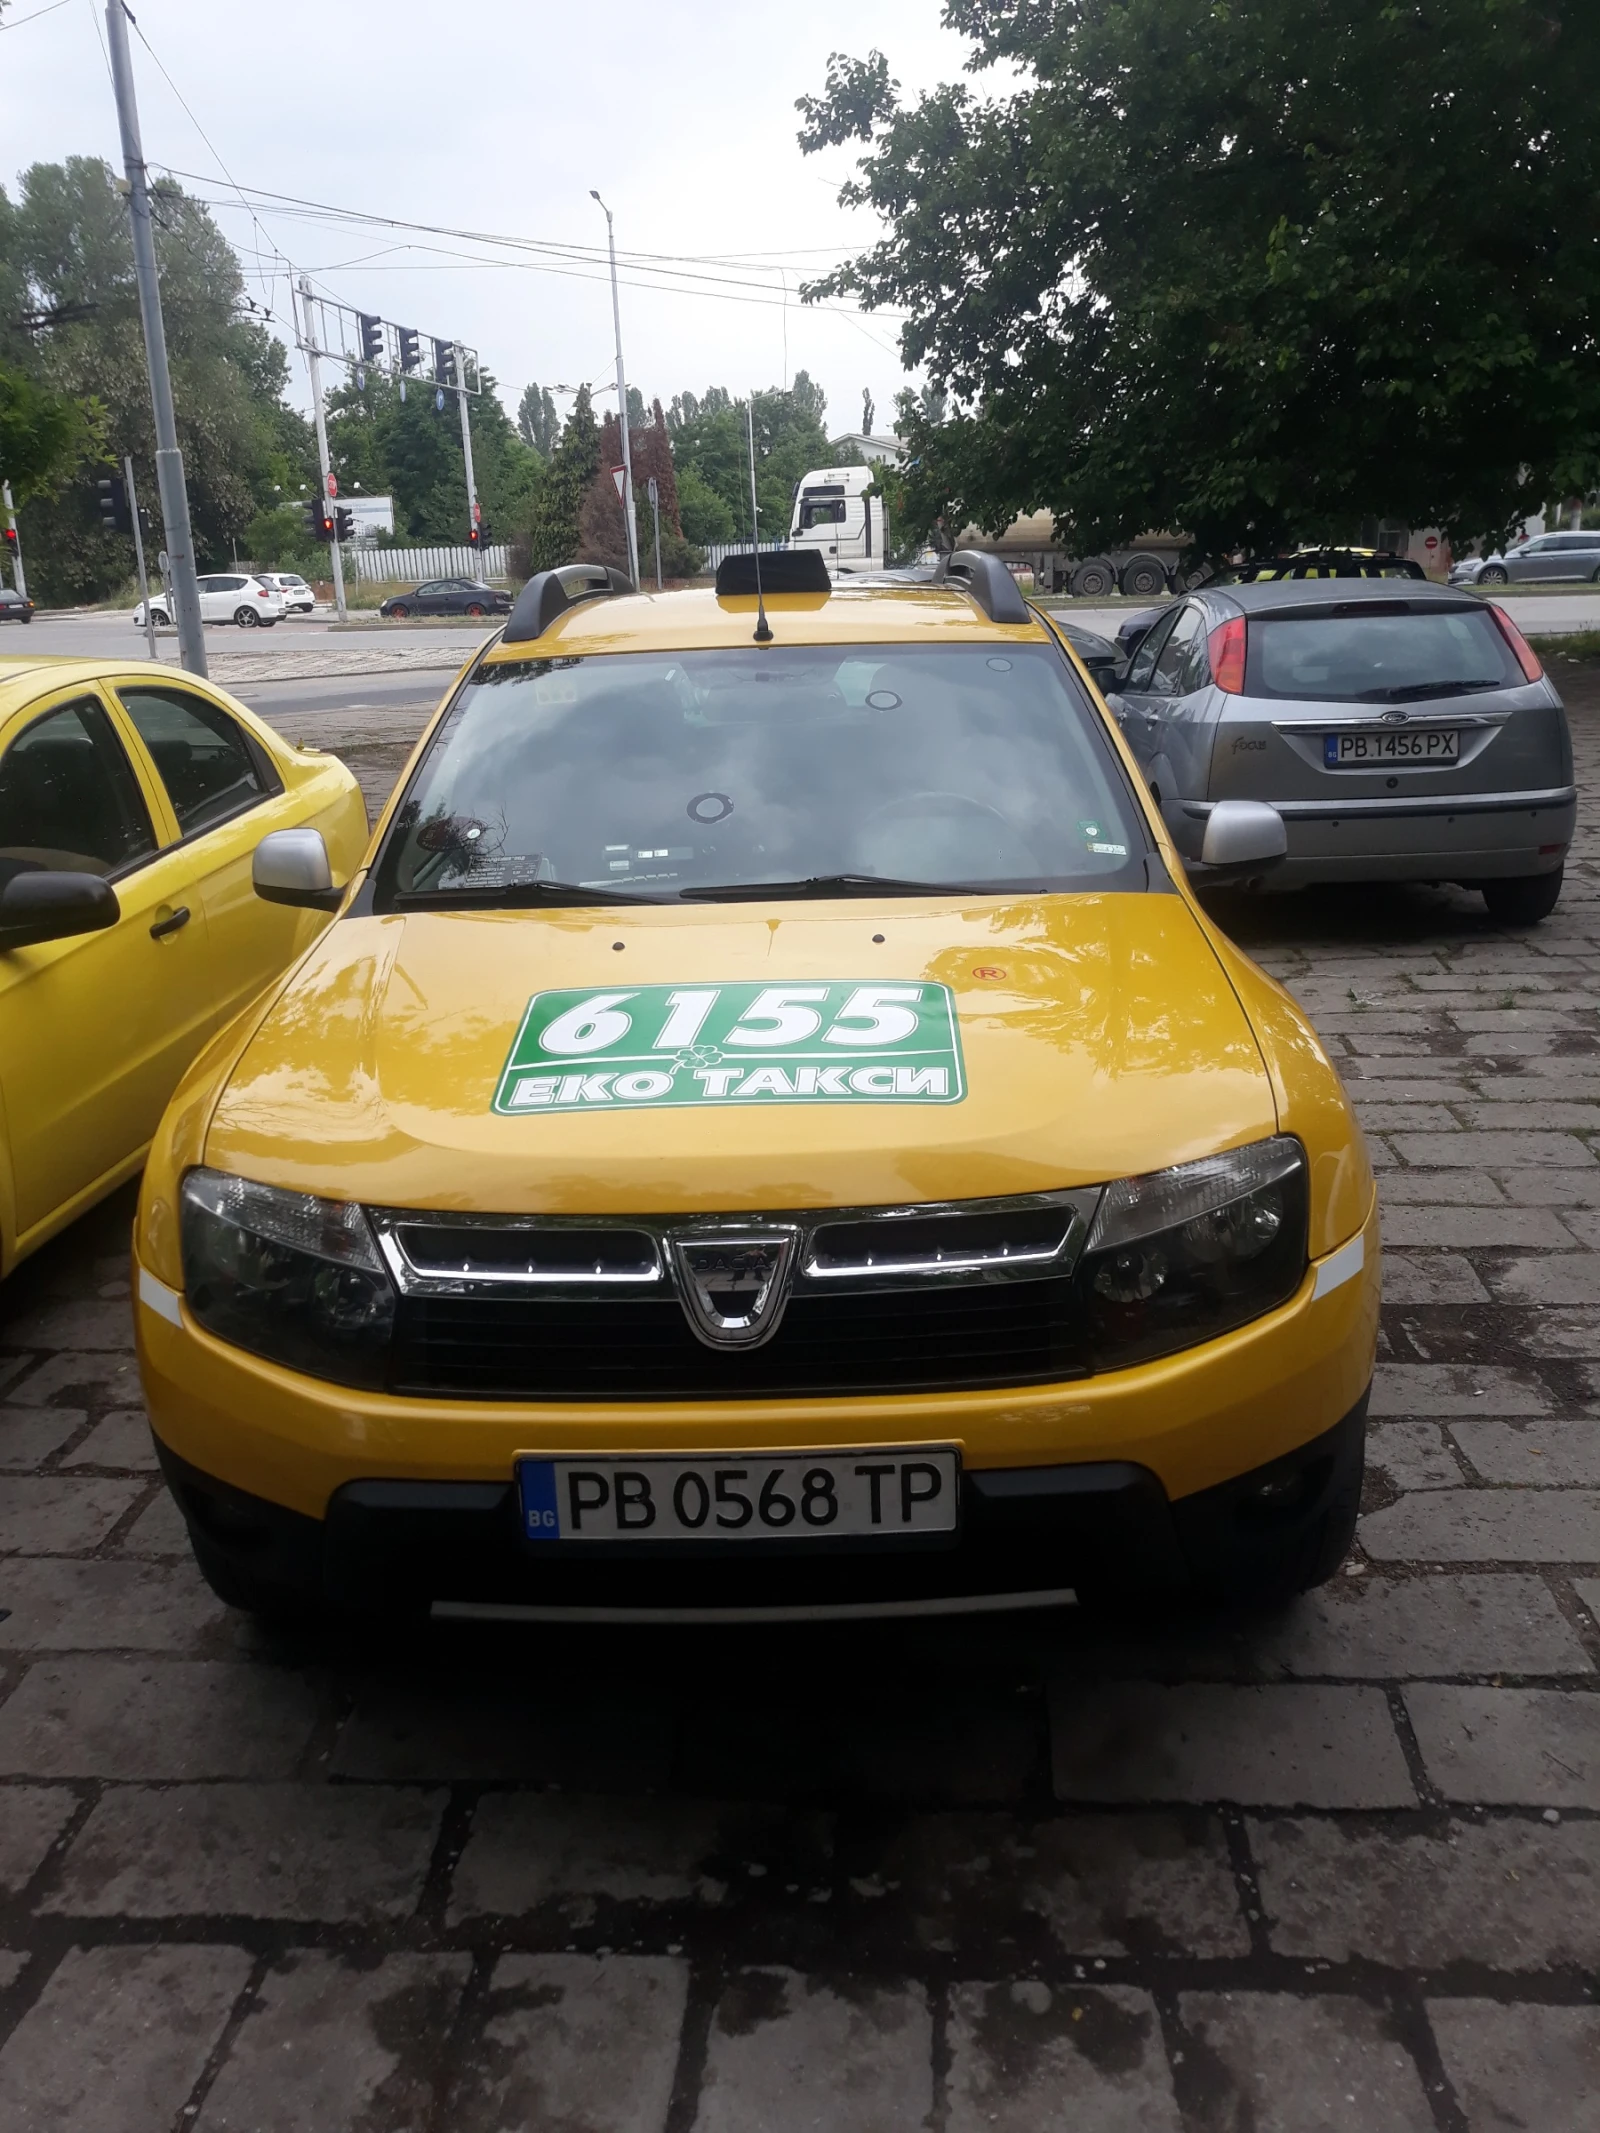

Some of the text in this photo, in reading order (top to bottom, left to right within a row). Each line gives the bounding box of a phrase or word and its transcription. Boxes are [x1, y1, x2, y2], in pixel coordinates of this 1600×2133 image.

[1340, 733, 1455, 758] PB 1456 PX
[538, 987, 924, 1055] 6155
[508, 1066, 951, 1108] ЕКО ТАКСИ
[567, 1462, 943, 1530] PB 0568 TP
[528, 1510, 556, 1528] BG
